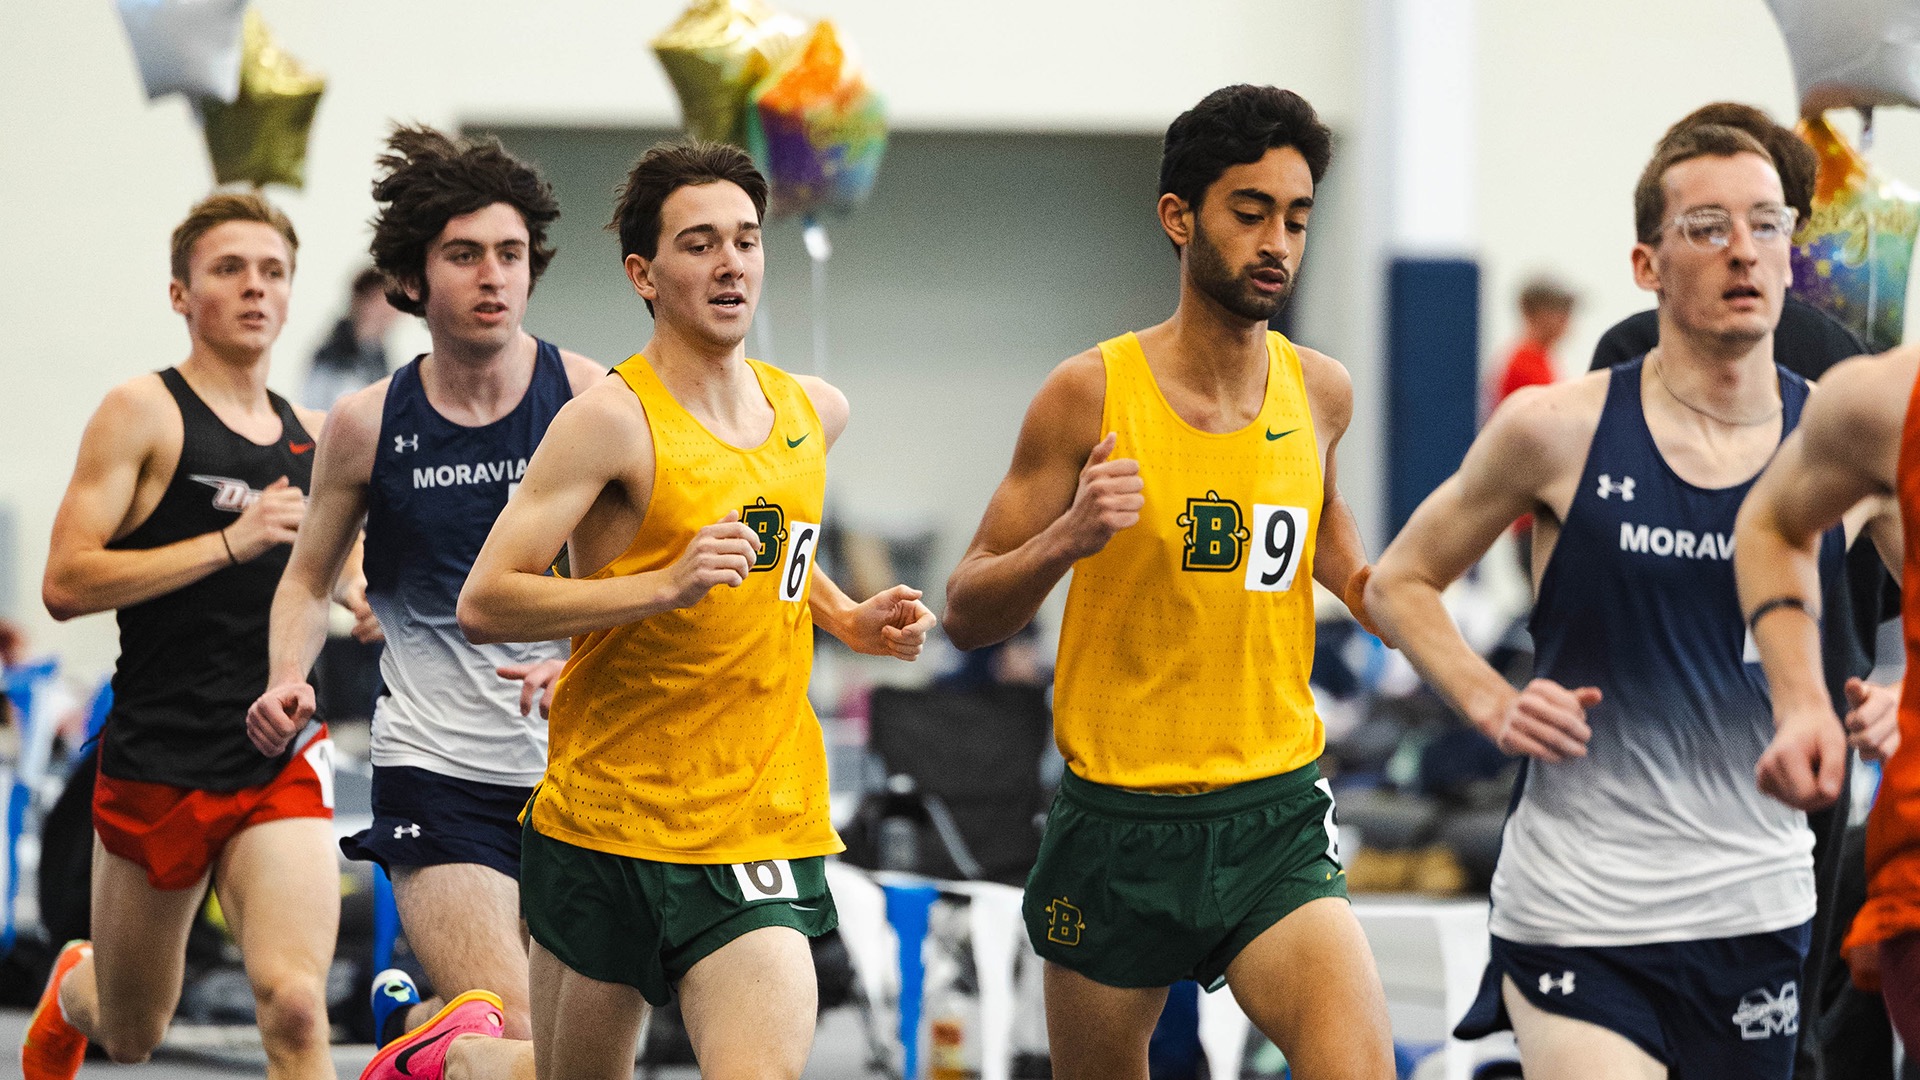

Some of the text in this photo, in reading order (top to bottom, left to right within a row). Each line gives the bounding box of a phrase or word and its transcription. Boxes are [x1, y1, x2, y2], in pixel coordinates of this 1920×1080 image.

[738, 497, 787, 572] B
[786, 528, 814, 598] 6
[1178, 491, 1249, 573] B
[1260, 509, 1296, 586] 9
[1046, 897, 1085, 946] B
